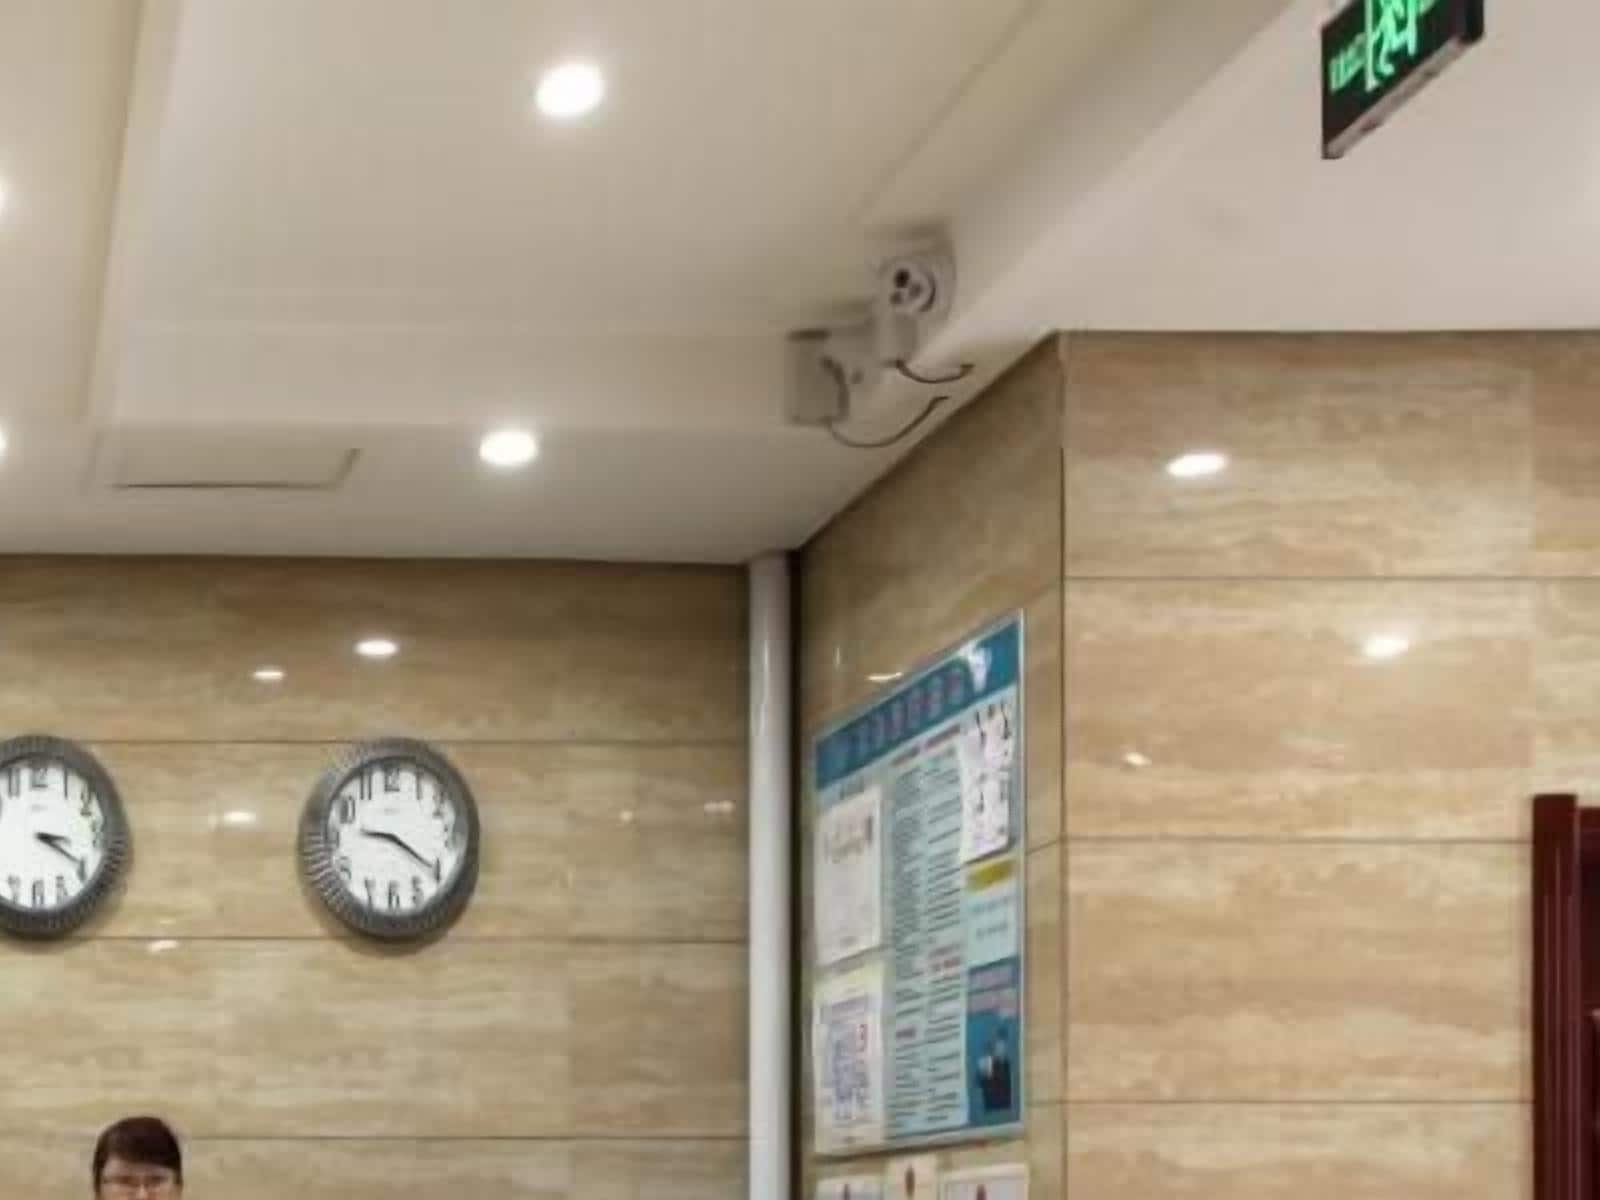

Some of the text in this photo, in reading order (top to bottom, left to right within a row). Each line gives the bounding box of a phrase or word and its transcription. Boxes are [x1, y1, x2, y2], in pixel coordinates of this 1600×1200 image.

[8, 767, 20, 798] 11
[30, 766, 48, 789] 12
[360, 770, 372, 800] 11
[384, 766, 400, 792] 12
[340, 796, 355, 824] 10
[8, 875, 21, 904] 7
[32, 878, 45, 907] 6
[365, 878, 376, 909] 7
[388, 880, 400, 910] 6
